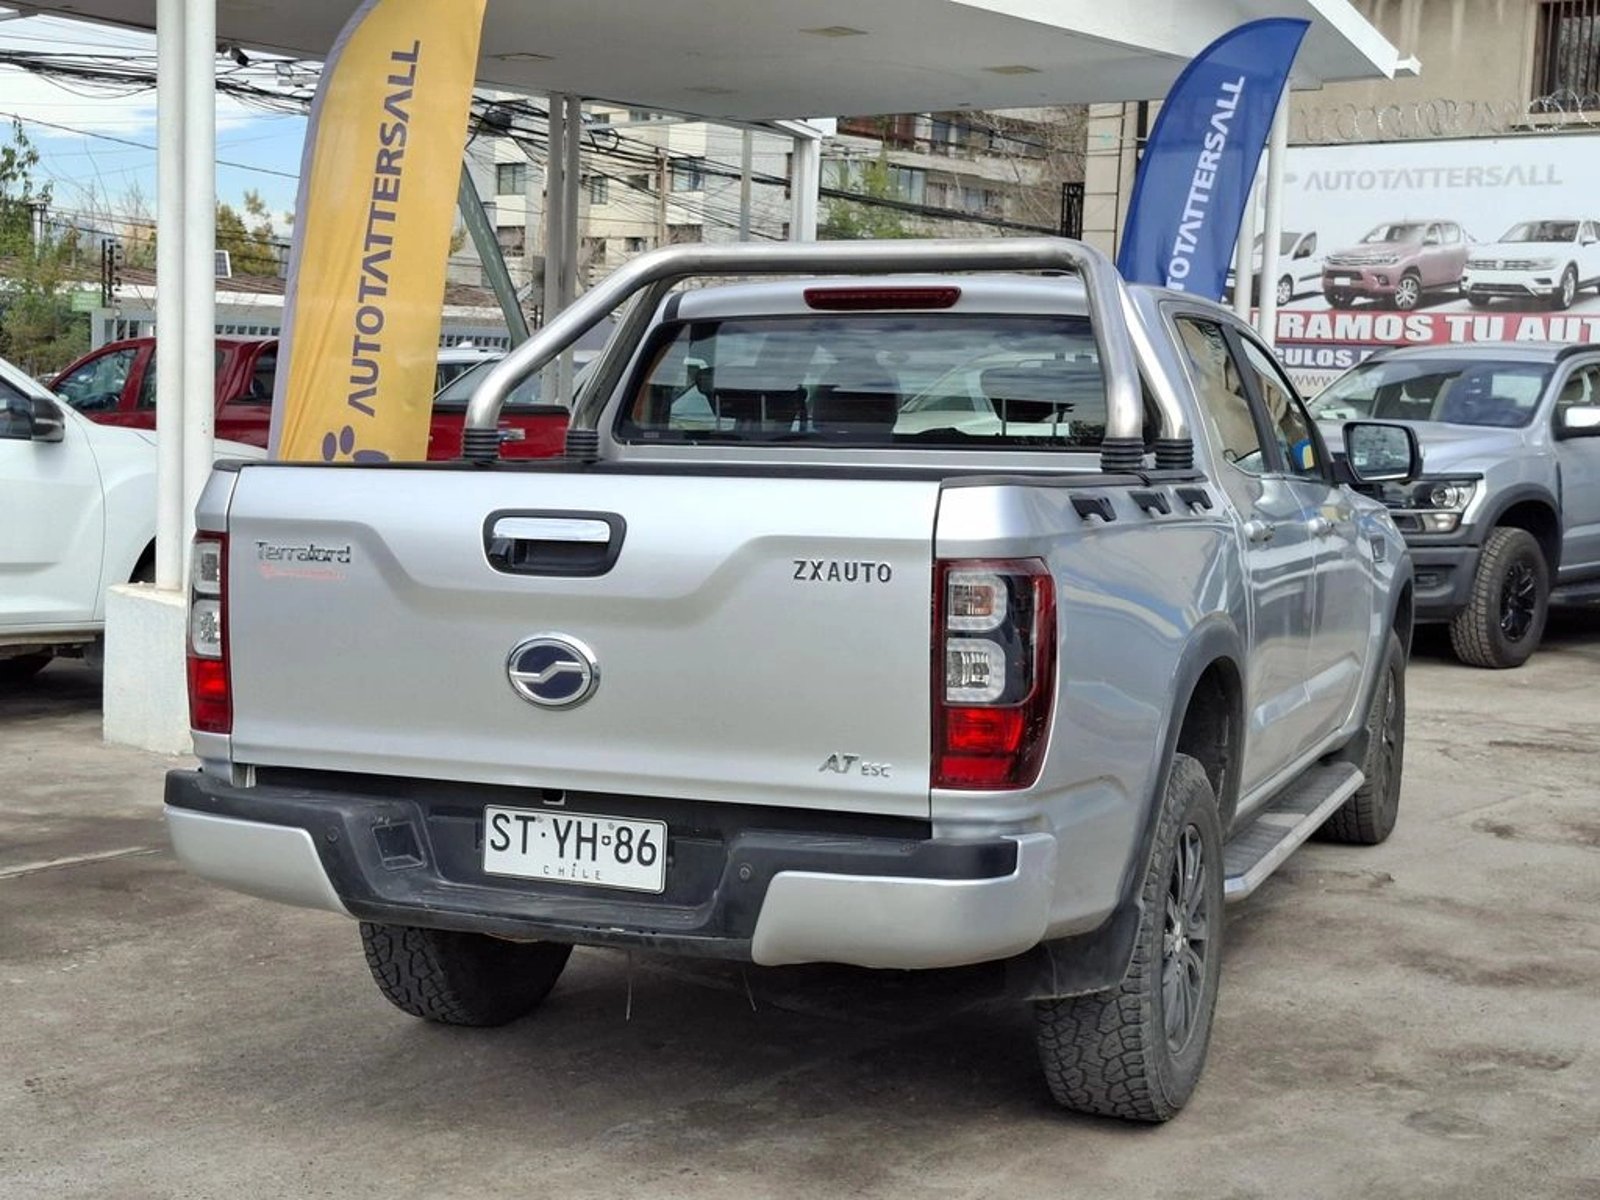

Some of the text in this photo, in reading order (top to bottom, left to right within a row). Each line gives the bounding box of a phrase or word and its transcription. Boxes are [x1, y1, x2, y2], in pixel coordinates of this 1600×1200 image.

[1303, 164, 1564, 192] AUTOTATTERSALL
[347, 39, 421, 418] AUTOTATTERSALL
[1252, 311, 1433, 343] RAMOS
[1445, 315, 1504, 342] TU
[792, 559, 892, 583] ZXAUTO
[818, 753, 892, 778] AT ESC
[542, 862, 602, 881] CHILE
